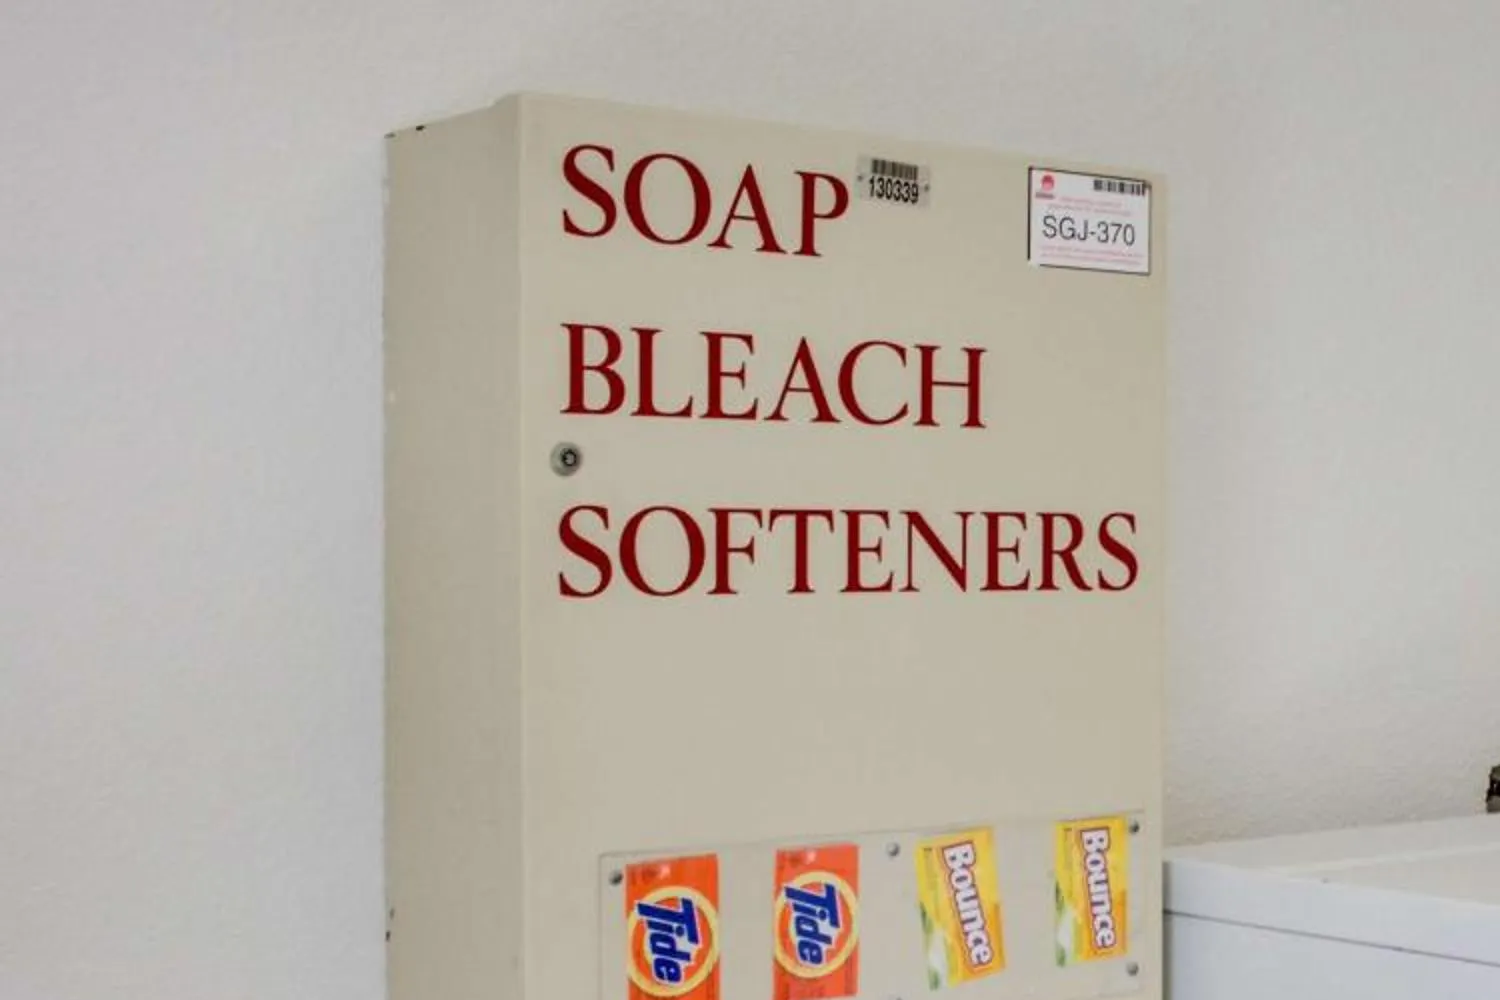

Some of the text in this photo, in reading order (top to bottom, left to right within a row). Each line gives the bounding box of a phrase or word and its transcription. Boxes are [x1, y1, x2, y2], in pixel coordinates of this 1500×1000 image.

[563, 145, 849, 257] SOAP
[869, 176, 919, 204] 130339
[1042, 215, 1135, 246] SGJ-370
[561, 323, 986, 428] BLEACH
[558, 505, 1139, 598] SOFTENERS
[785, 883, 840, 965] Tide
[942, 841, 994, 967] Bounce
[1080, 827, 1116, 949] Bounce
[637, 897, 699, 983] Tide
